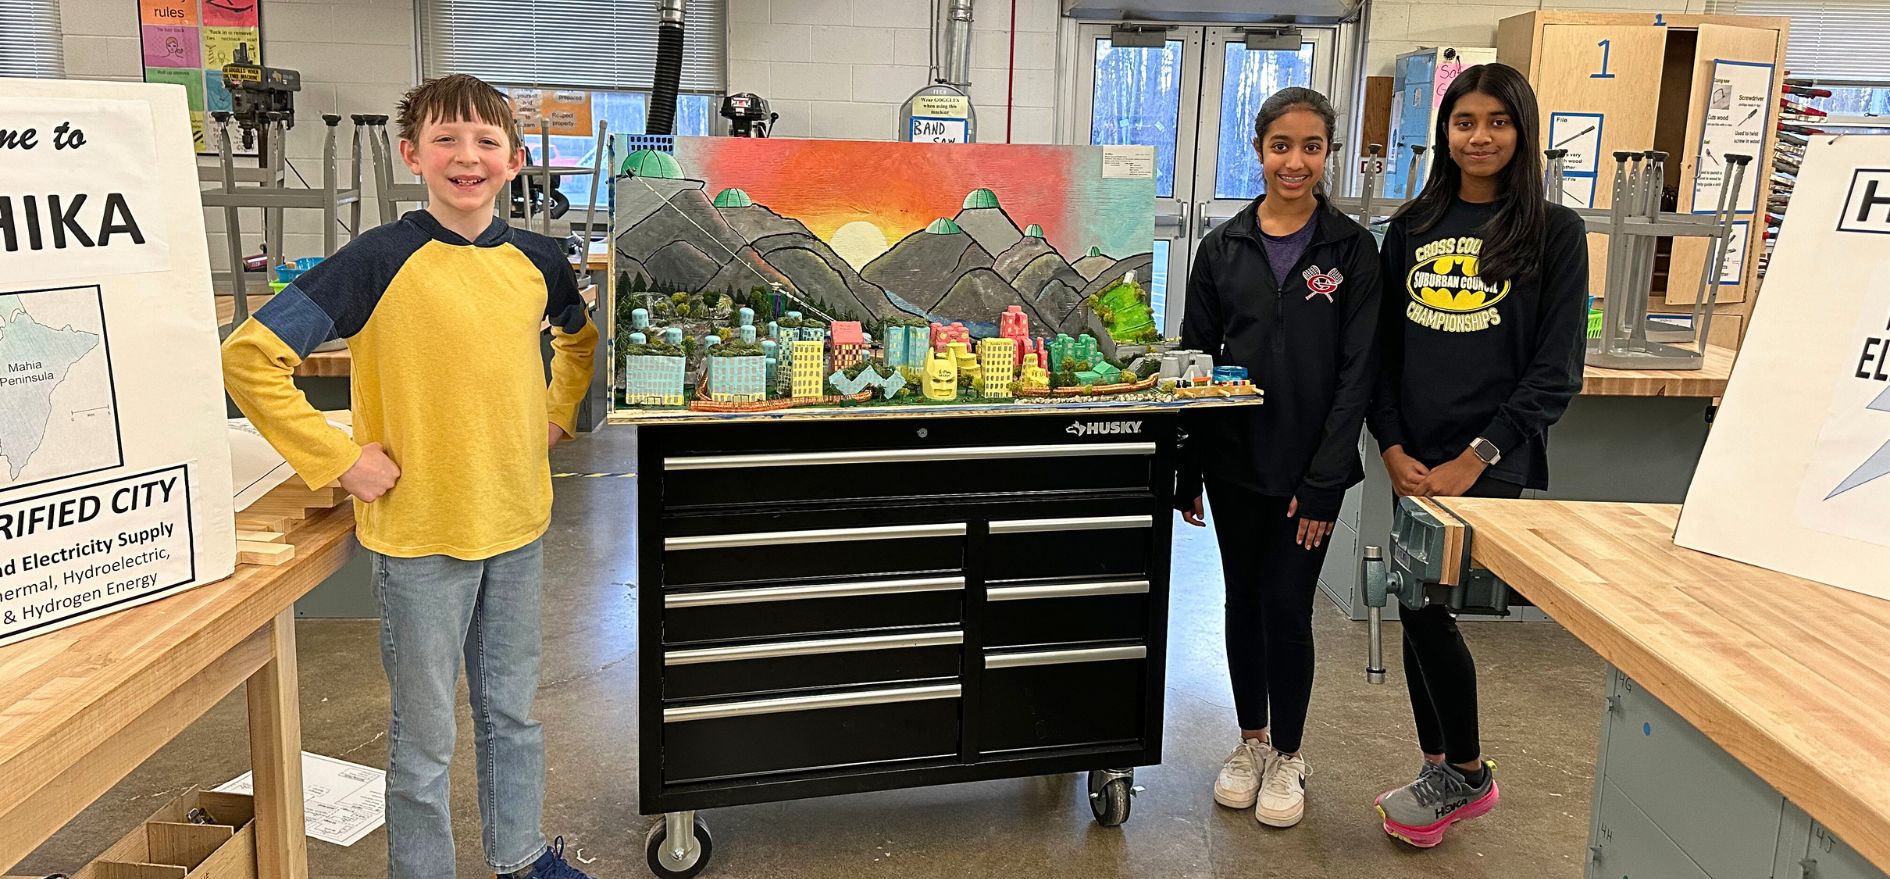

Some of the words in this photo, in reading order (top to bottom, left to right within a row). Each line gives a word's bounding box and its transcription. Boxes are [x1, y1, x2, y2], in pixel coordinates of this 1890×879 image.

[154, 6, 185, 18] rules
[1653, 13, 1667, 27] 1
[1590, 39, 1615, 78] 1
[53, 121, 87, 150] to
[913, 120, 946, 136] BAND
[1415, 238, 1456, 262] CROSS
[1413, 271, 1460, 288] SUBURBAN
[1406, 301, 1501, 332] CHAMPIONSHIPS
[8, 361, 42, 373] Mahia
[0, 372, 54, 387] Peninsula
[1086, 421, 1142, 435] HUSKY
[111, 476, 177, 514] CITY
[22, 538, 113, 571] Electricity
[118, 521, 174, 547] Supply
[0, 576, 58, 601] ermal,
[63, 548, 170, 585] Hydroelectric,
[3, 610, 17, 625] &
[23, 588, 101, 619] Hydrogen
[107, 572, 157, 596] Energy
[1435, 799, 1468, 819] HOKA
